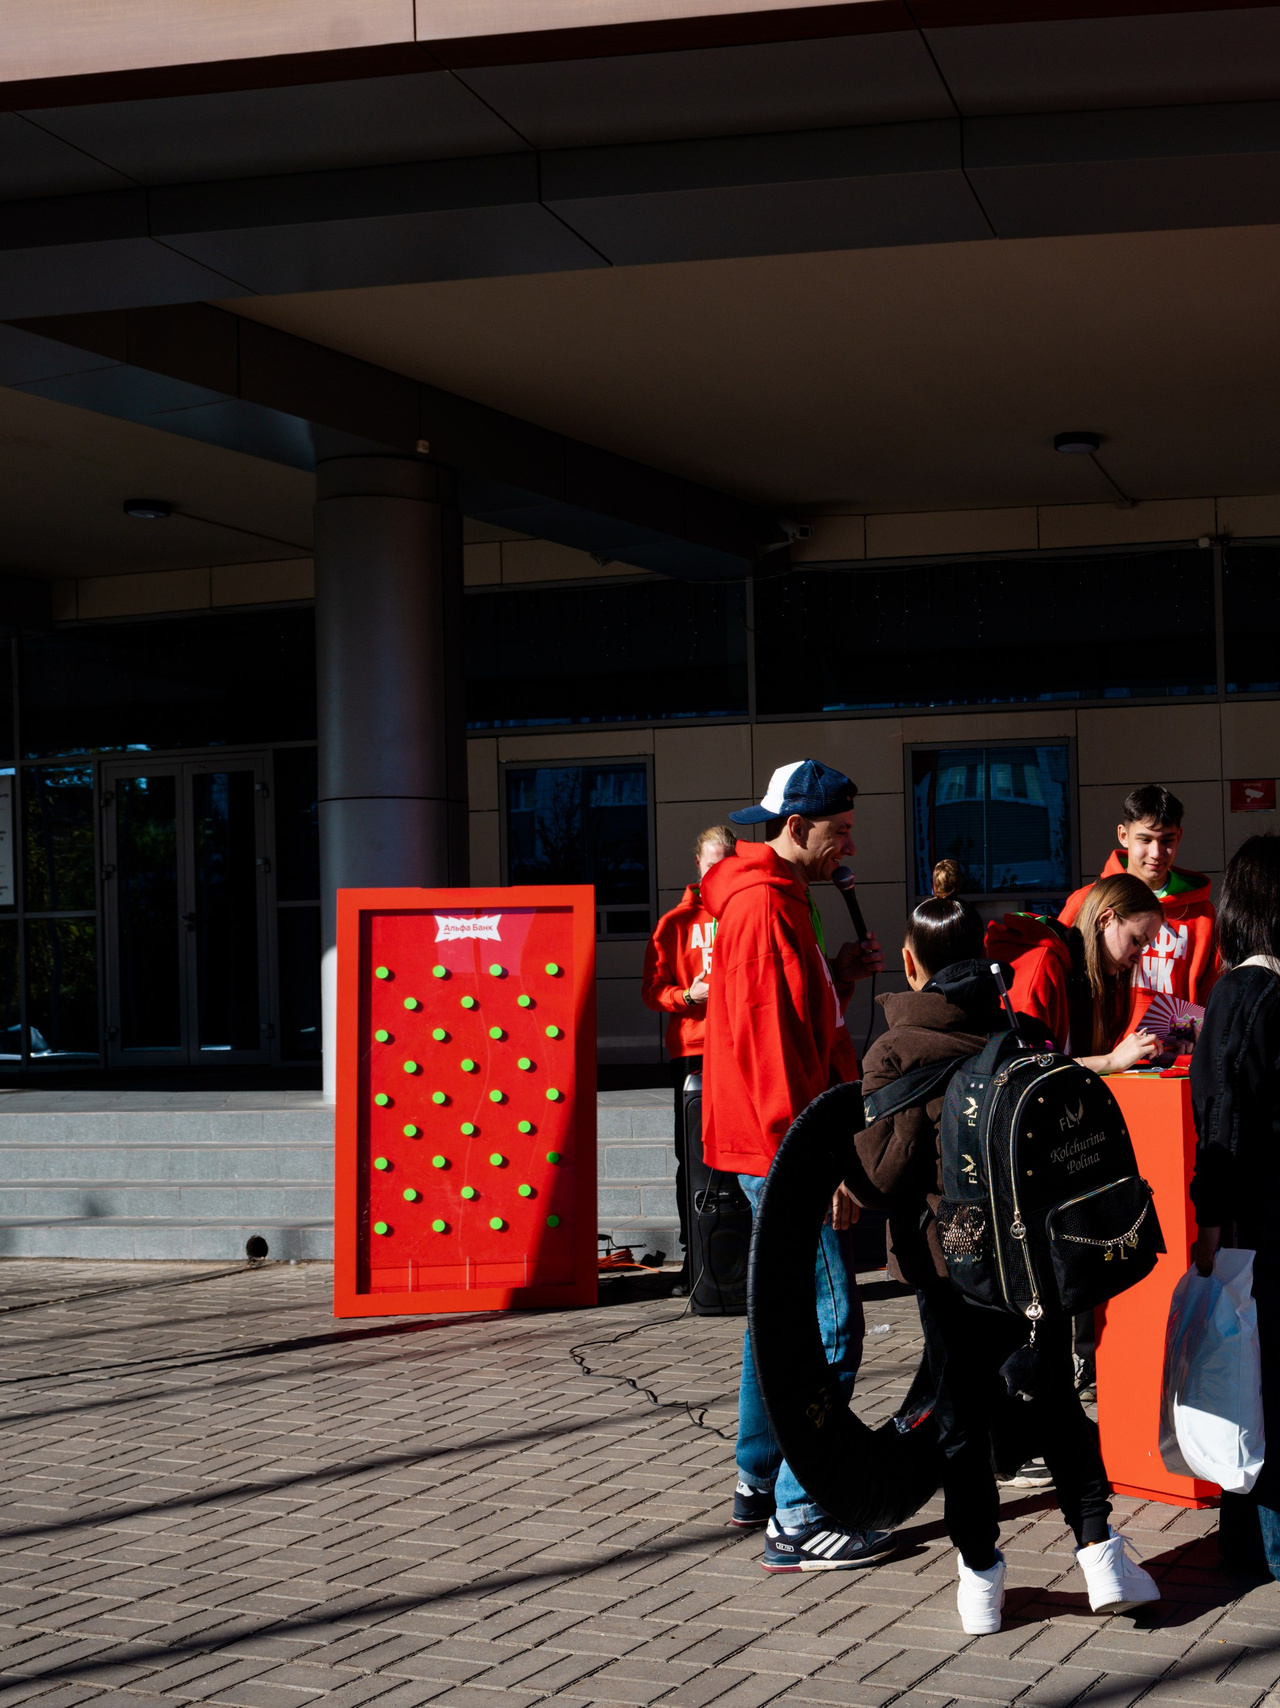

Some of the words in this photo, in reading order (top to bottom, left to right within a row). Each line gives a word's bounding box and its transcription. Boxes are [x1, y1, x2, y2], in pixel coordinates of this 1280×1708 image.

[443, 924, 471, 934] Альфа
[472, 923, 494, 931] Банк
[1142, 922, 1188, 960] ФА
[1050, 1130, 1107, 1164] Kolchurina
[1066, 1152, 1101, 1175] Polina
